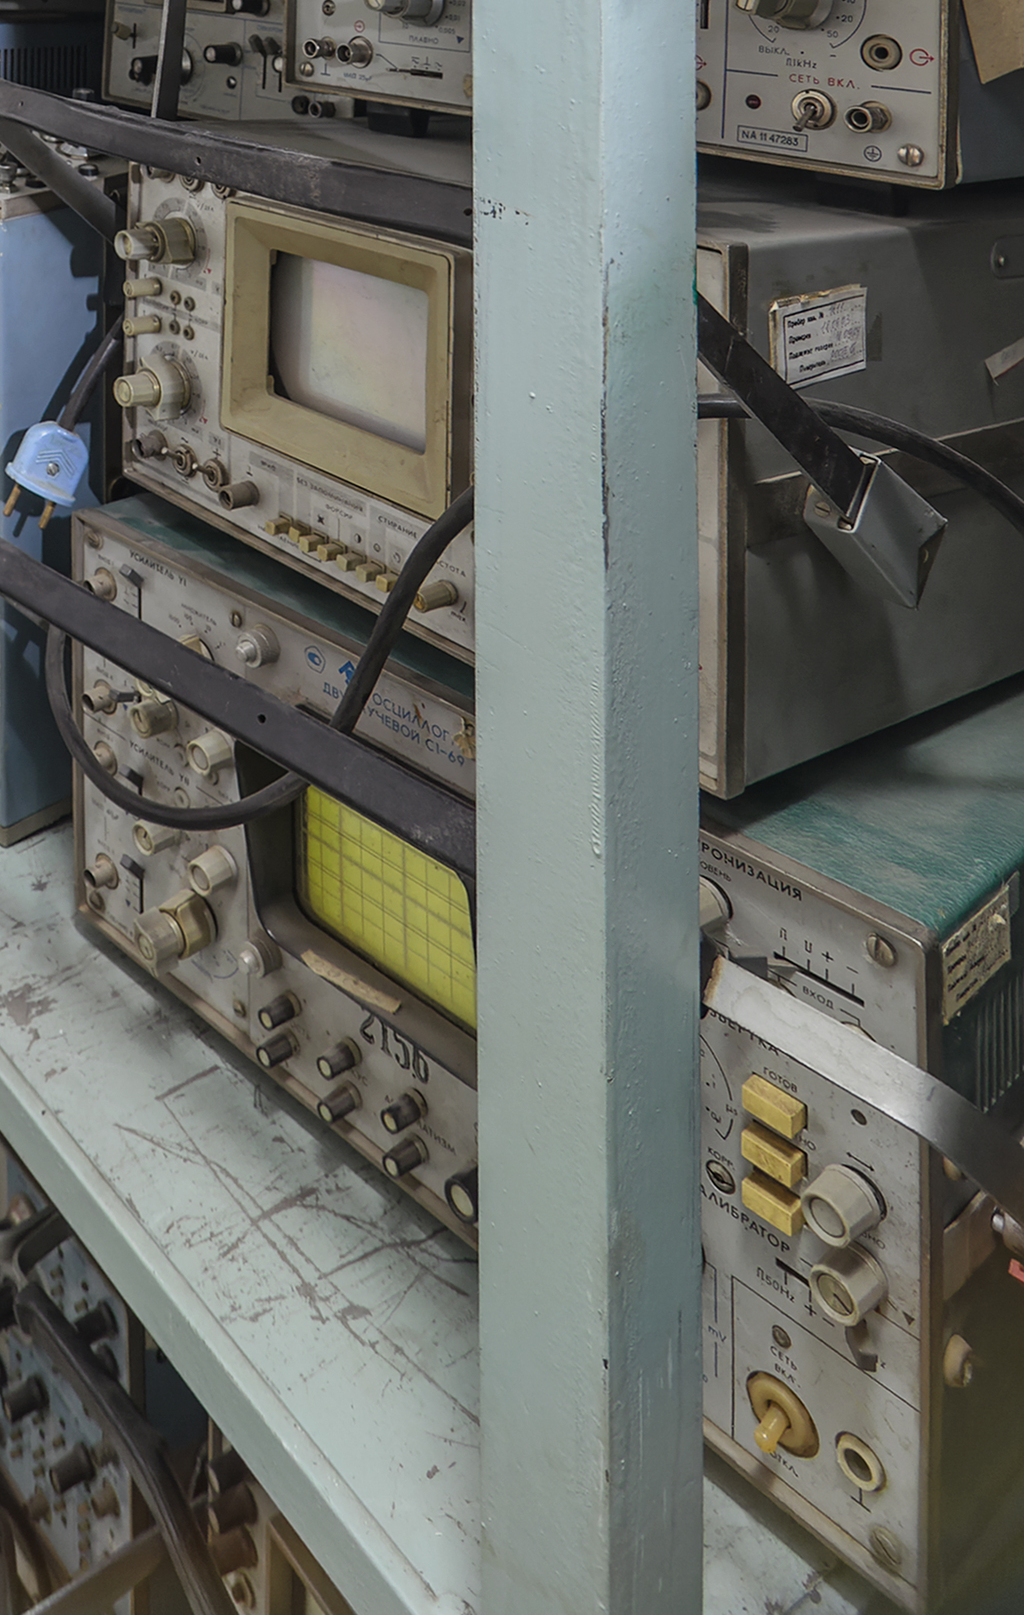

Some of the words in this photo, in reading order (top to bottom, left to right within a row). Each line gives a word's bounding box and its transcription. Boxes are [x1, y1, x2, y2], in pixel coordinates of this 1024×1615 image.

[767, 25, 780, 34] 20
[841, 14, 854, 23] 20
[408, 35, 439, 45] ПЛАВНО
[826, 30, 839, 39] 50
[758, 45, 790, 56] ВЫКЛ.
[788, 73, 820, 85] СЕТЬ
[827, 77, 860, 90] ВКЛ.
[377, 515, 419, 540] СТИРАНИЕ
[129, 549, 175, 581] УСИЛИТЕЛЬ
[129, 740, 175, 776] УСИЛИТЕЛЬ
[699, 842, 803, 901] РОНИЗАЦИЯ
[802, 985, 835, 1009] ВХОД
[762, 1066, 799, 1094] ГОТОВ
[769, 1345, 799, 1372] СЕТЬ
